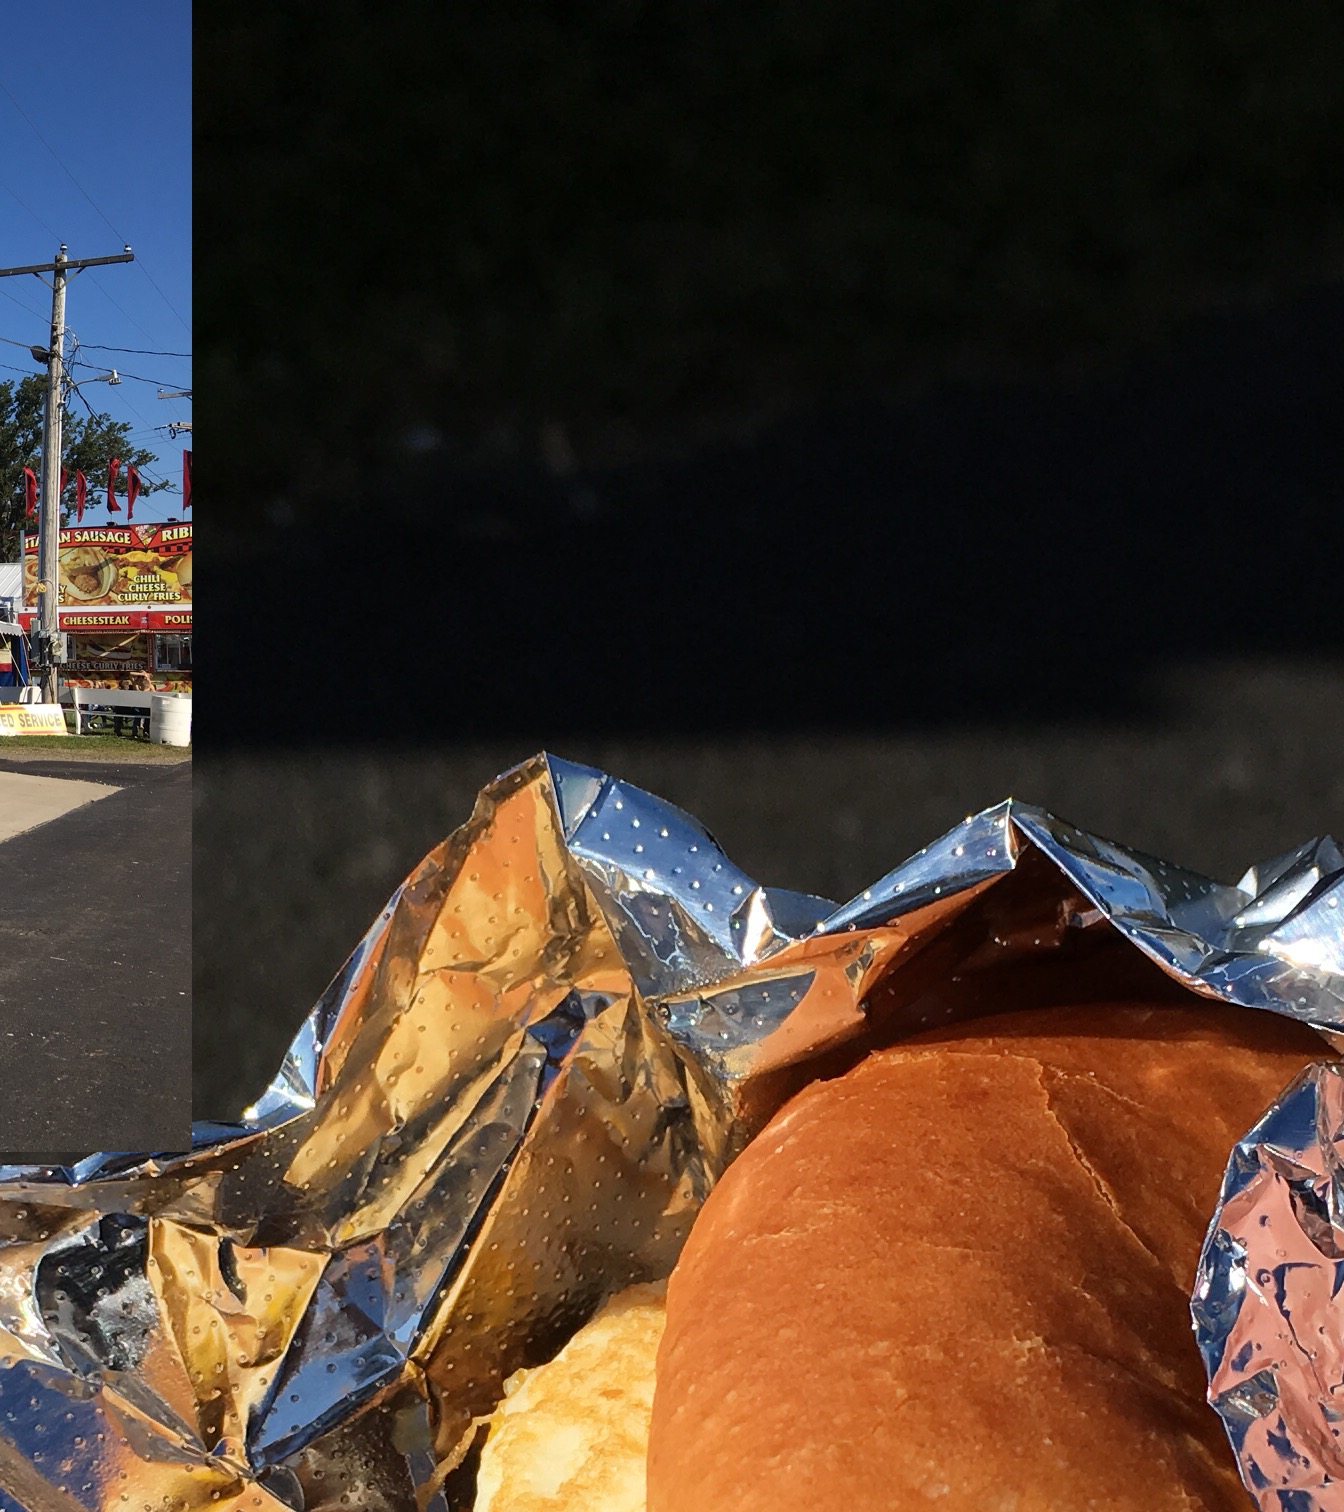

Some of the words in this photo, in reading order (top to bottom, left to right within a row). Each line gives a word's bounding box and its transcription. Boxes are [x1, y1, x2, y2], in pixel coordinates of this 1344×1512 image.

[74, 531, 131, 544] SAUSAGE
[133, 574, 160, 583] CHILI
[128, 583, 166, 592] CHEESE
[117, 592, 149, 601] CURLY
[154, 592, 181, 600] FRIES
[63, 616, 130, 625] CHEESESTEAK
[165, 615, 192, 624] POLI
[18, 712, 62, 728] SERVICE
